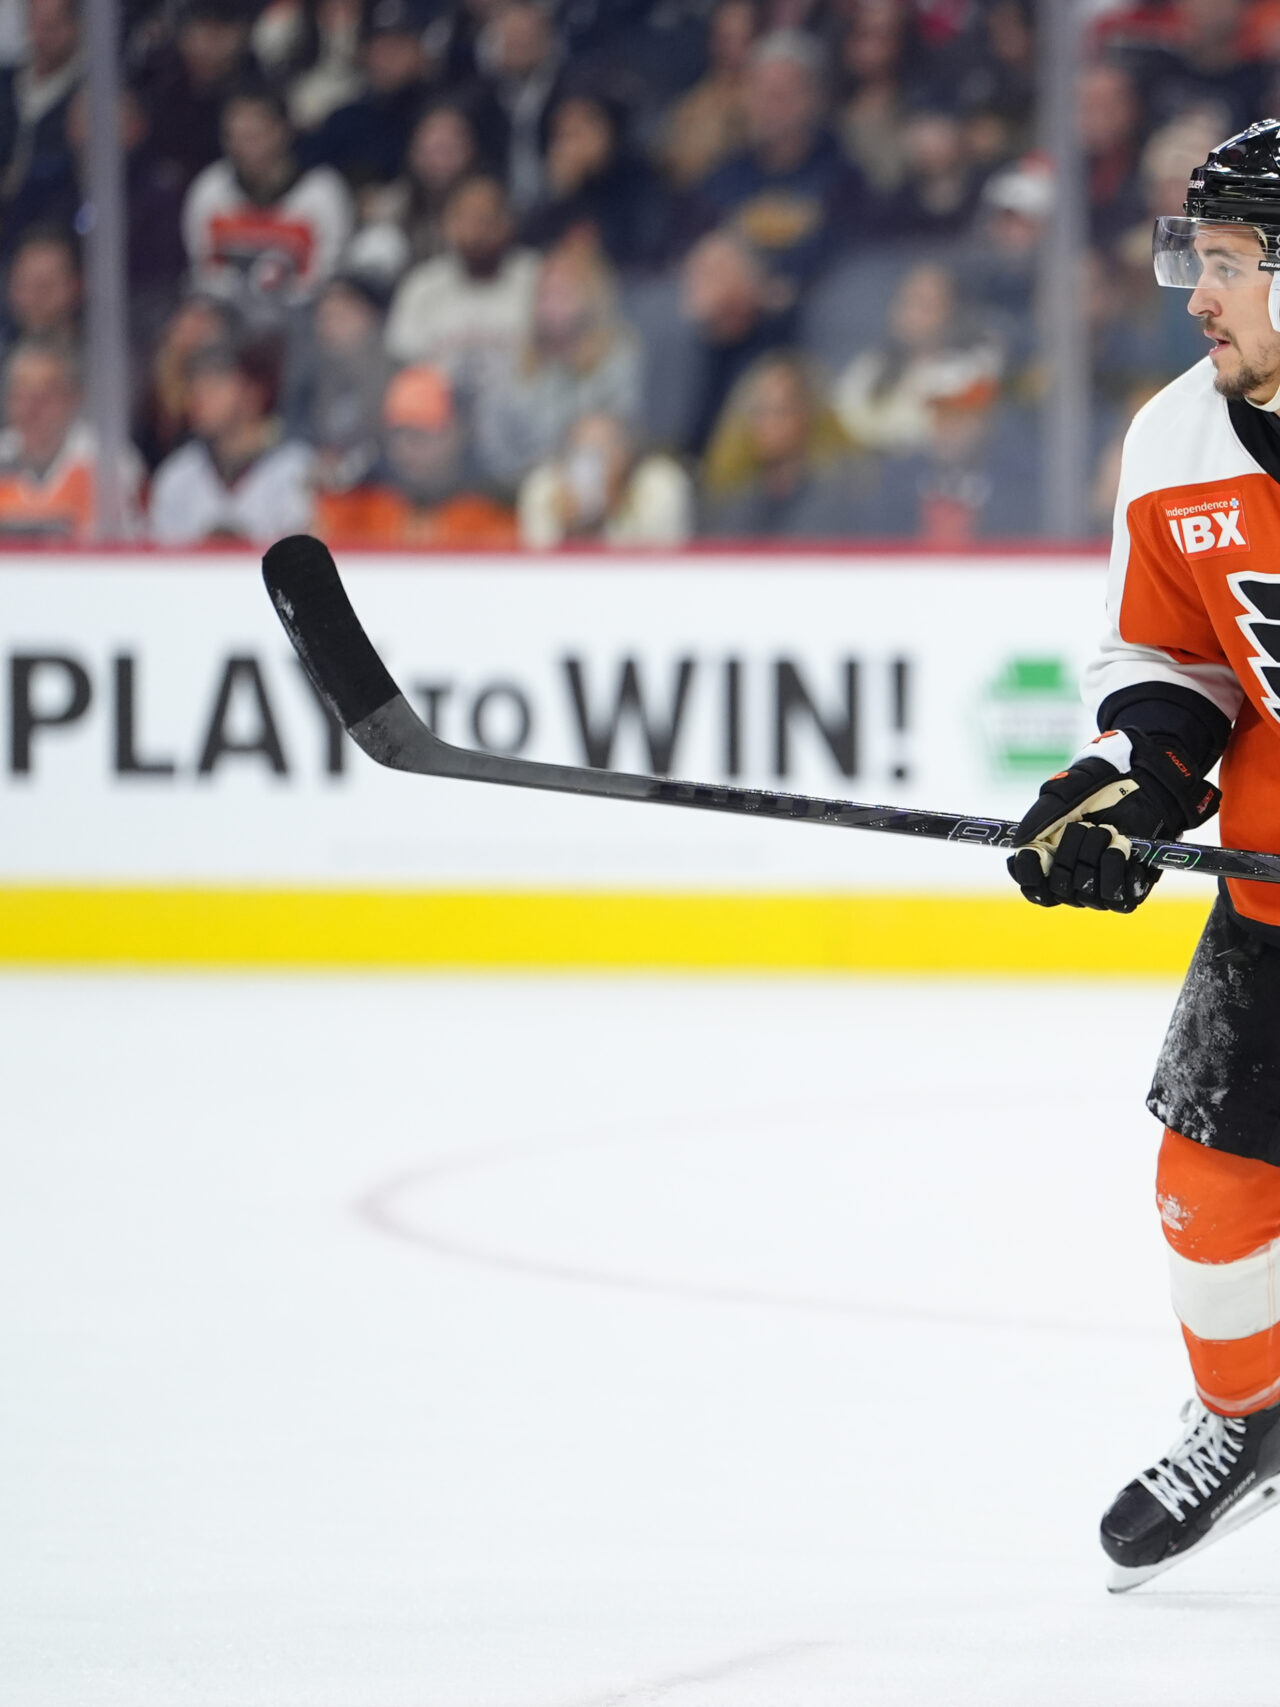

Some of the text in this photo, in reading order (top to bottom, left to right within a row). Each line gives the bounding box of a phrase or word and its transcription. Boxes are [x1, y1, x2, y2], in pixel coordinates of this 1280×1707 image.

[1165, 500, 1229, 518] Independence
[1168, 509, 1247, 554] IBX
[563, 655, 911, 779] WIN!
